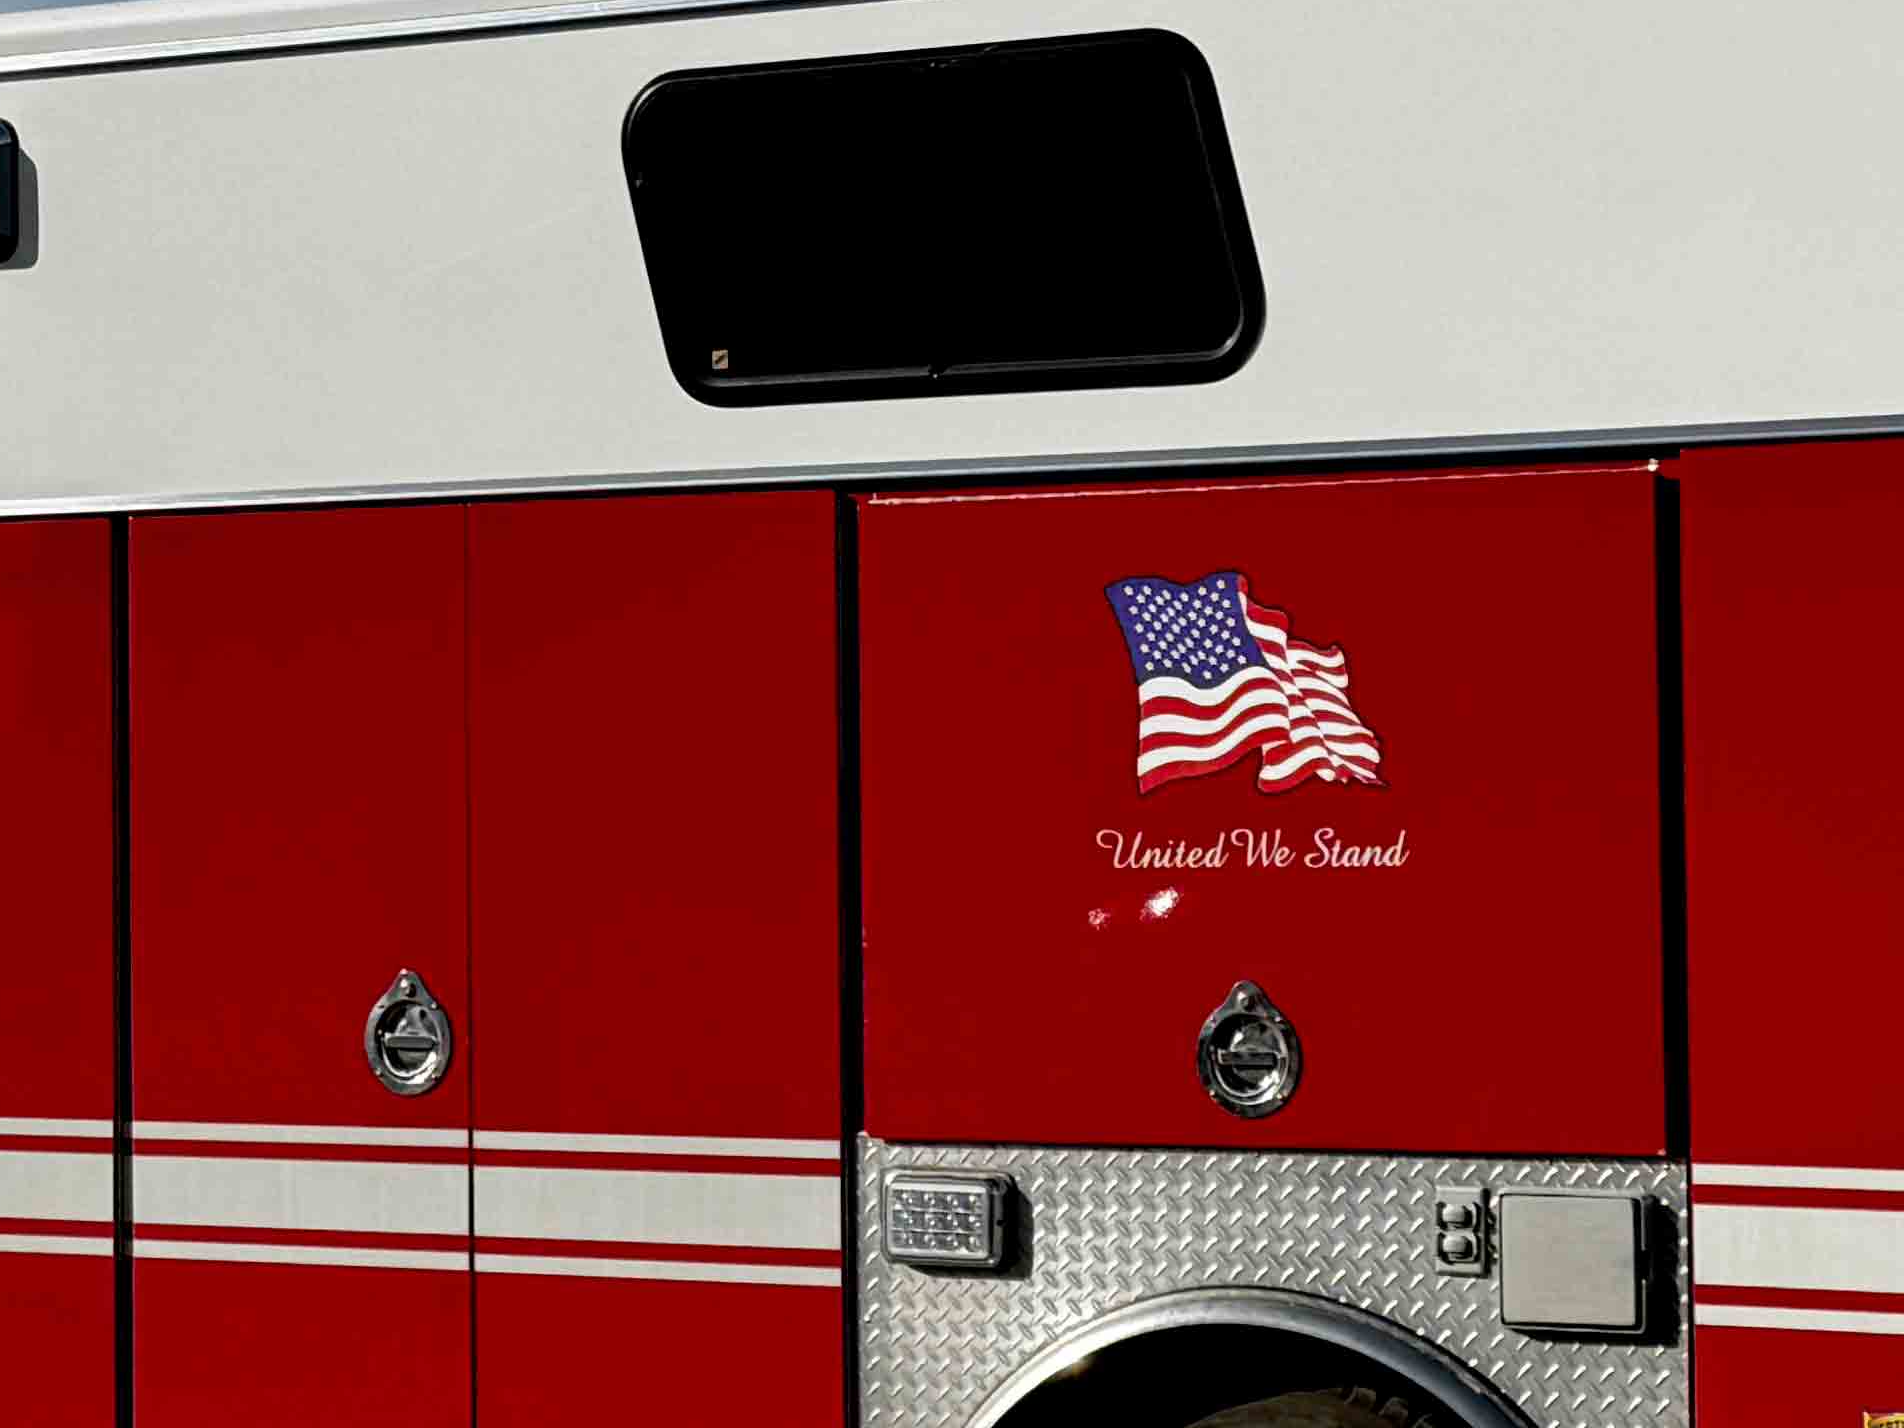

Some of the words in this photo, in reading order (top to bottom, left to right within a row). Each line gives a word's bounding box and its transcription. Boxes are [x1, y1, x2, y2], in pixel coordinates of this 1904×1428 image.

[1096, 829, 1229, 869] United
[1231, 829, 1296, 869] We
[1304, 827, 1409, 869] Stand
